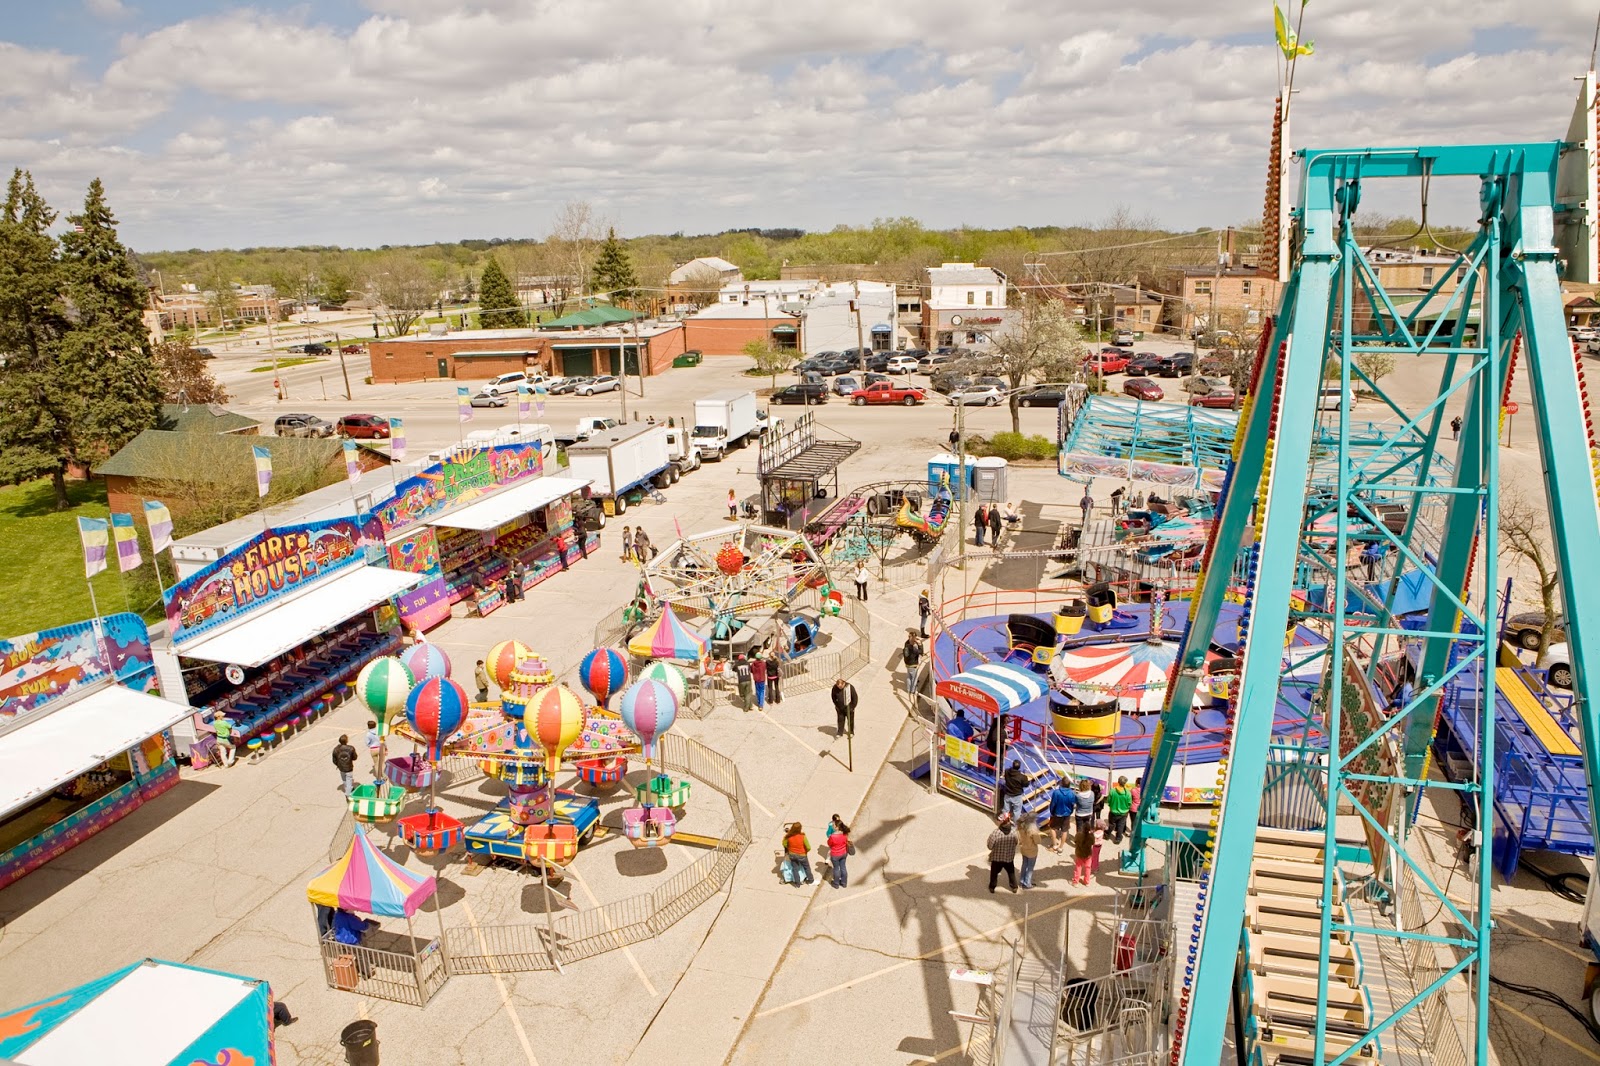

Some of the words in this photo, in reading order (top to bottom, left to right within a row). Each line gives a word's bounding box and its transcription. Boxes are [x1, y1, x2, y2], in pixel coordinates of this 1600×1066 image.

[443, 451, 490, 485] PRIZE
[444, 471, 490, 501] FACTORY
[245, 533, 297, 572] FIRE
[232, 548, 317, 608] HOUSE
[413, 596, 427, 608] FUN
[10, 640, 42, 667] FUN
[20, 676, 51, 696] FUN
[950, 684, 986, 702] TILT-A-WHIRL
[955, 782, 980, 797] WCA
[1, 852, 14, 862] FUN
[42, 829, 55, 839] FUN
[76, 810, 89, 821] FUN
[111, 790, 123, 800] FUN
[30, 847, 43, 857] FUN
[65, 829, 78, 839] FUN
[101, 806, 113, 816] FUN
[12, 868, 25, 879] FUN
[53, 846, 65, 856] FUN
[88, 824, 100, 834] FUN
